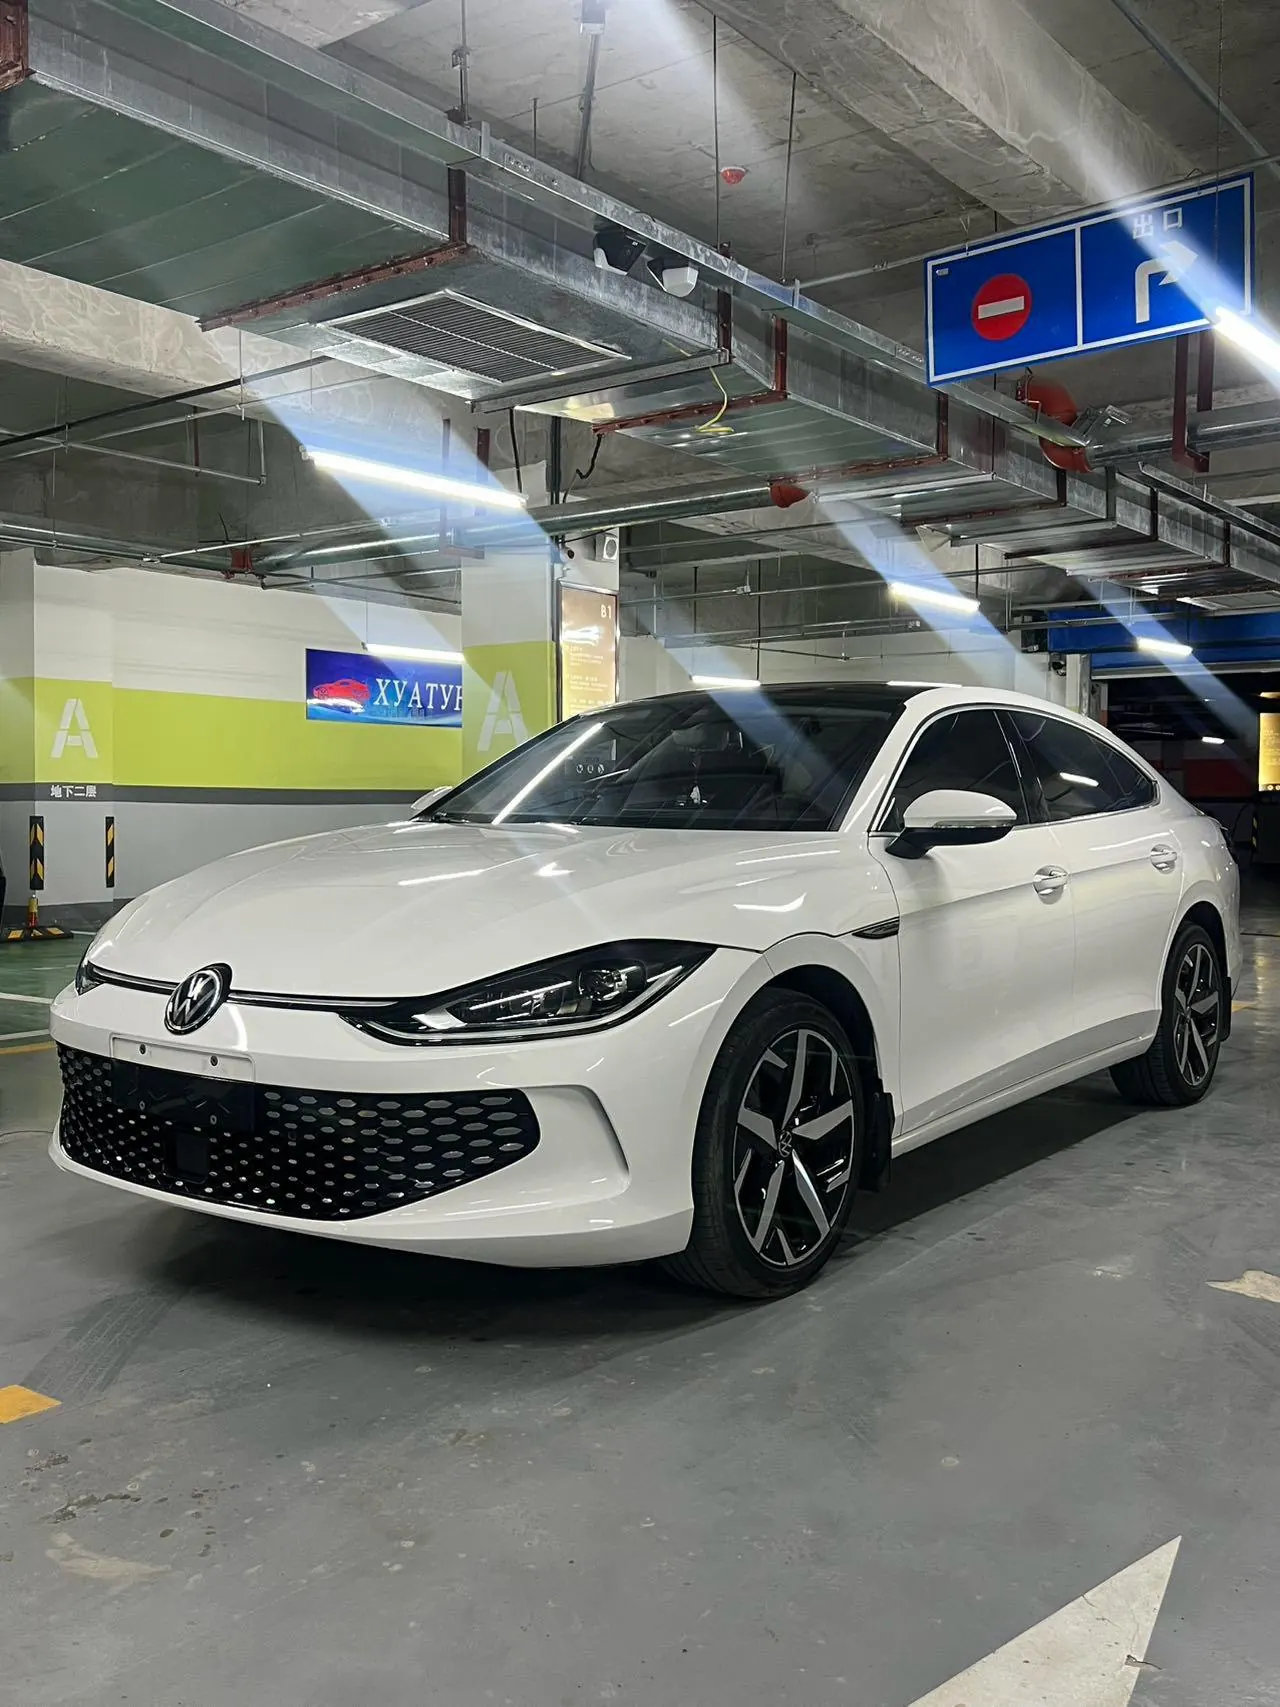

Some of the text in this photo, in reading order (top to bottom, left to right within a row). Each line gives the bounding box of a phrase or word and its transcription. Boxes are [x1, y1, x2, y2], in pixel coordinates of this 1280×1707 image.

[1132, 207, 1183, 240] 出口
[600, 604, 612, 619] B1
[477, 671, 530, 752] A
[50, 698, 98, 759] A
[50, 785, 97, 798] 地下二层
